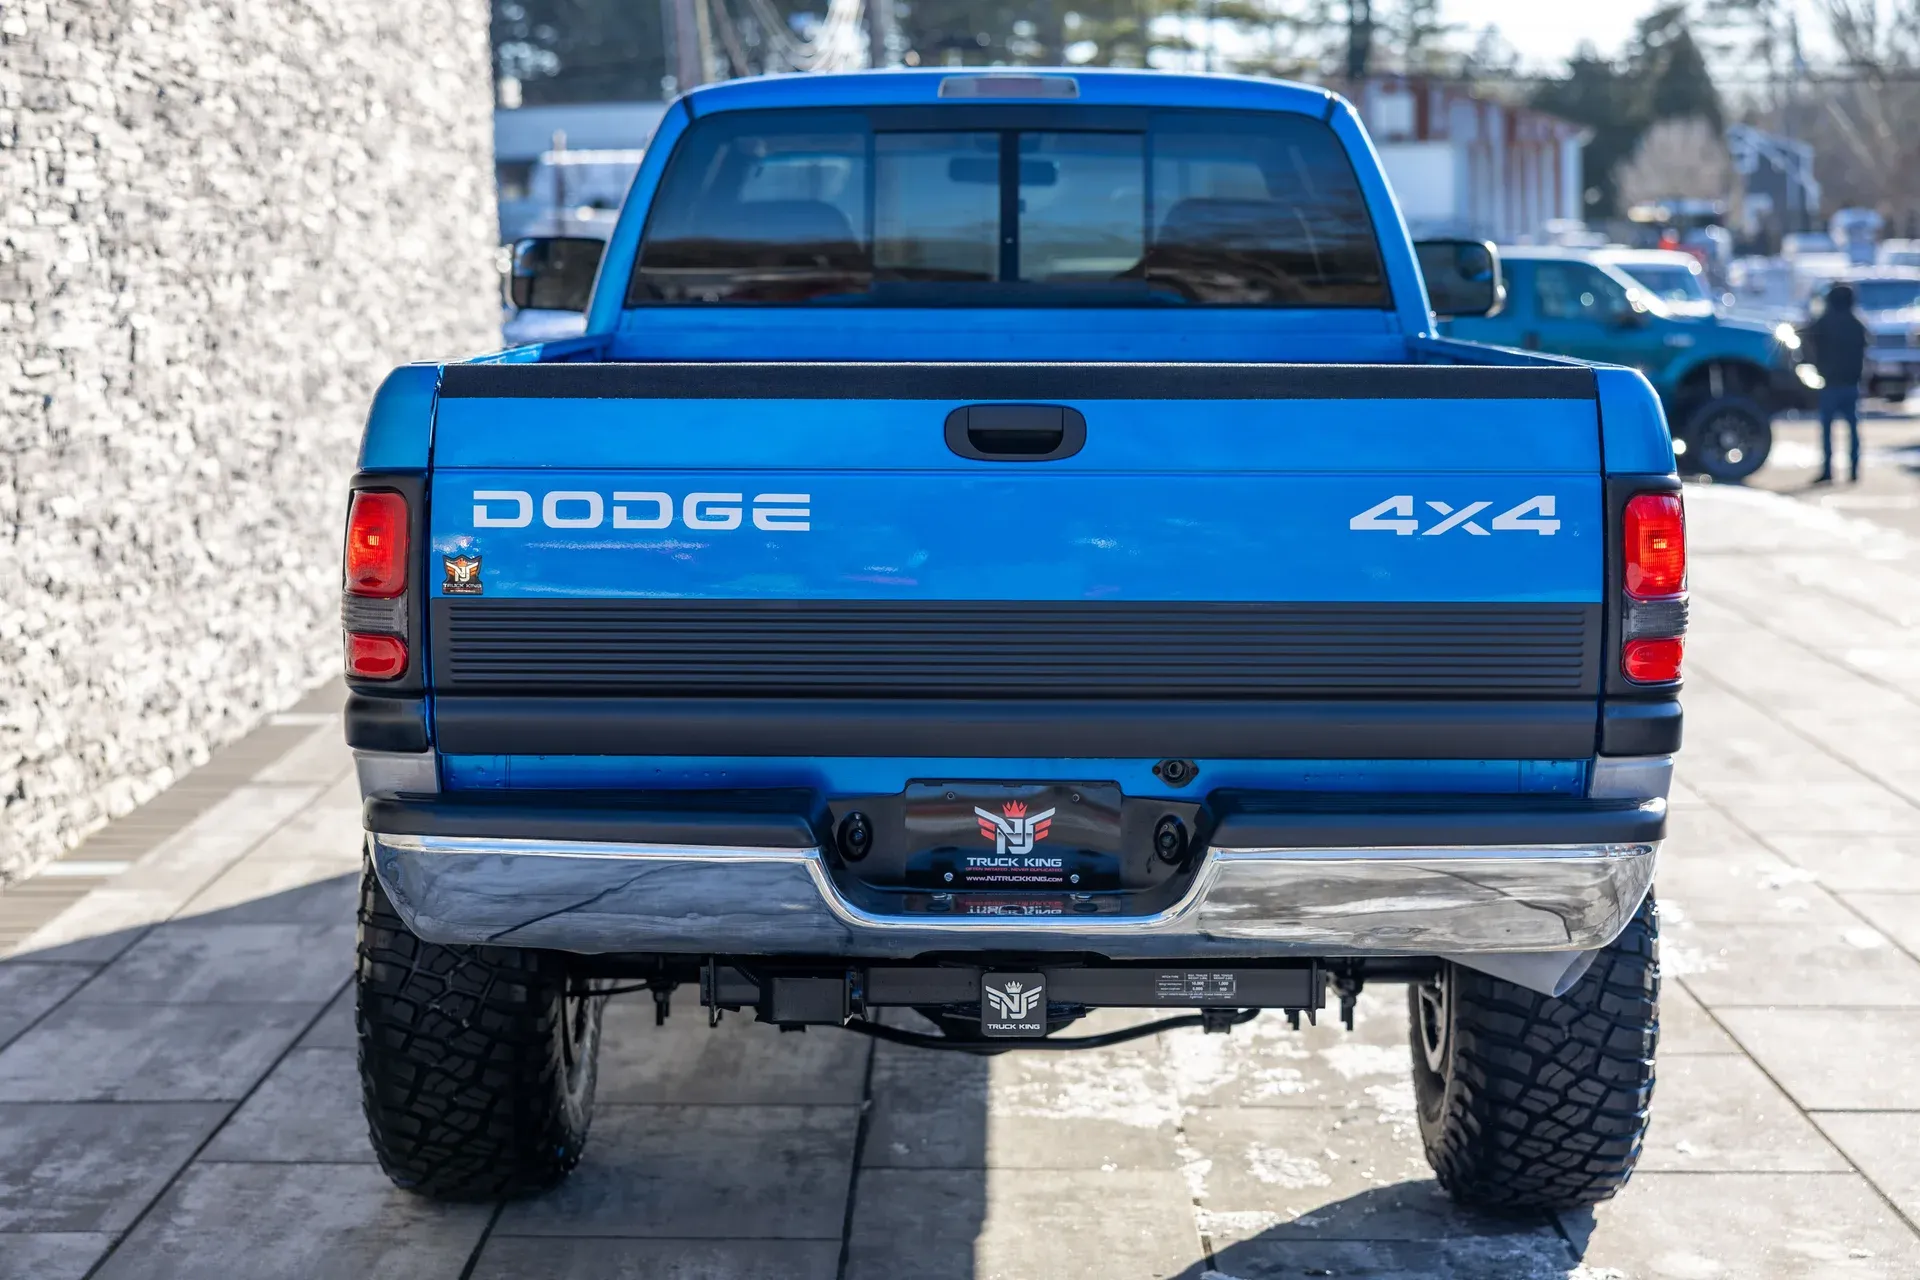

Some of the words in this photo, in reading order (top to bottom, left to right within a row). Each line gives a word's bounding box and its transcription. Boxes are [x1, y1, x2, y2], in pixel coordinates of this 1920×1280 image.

[473, 490, 810, 531] DODGE
[966, 857, 1020, 867] TRUCK
[1024, 858, 1063, 867] KING
